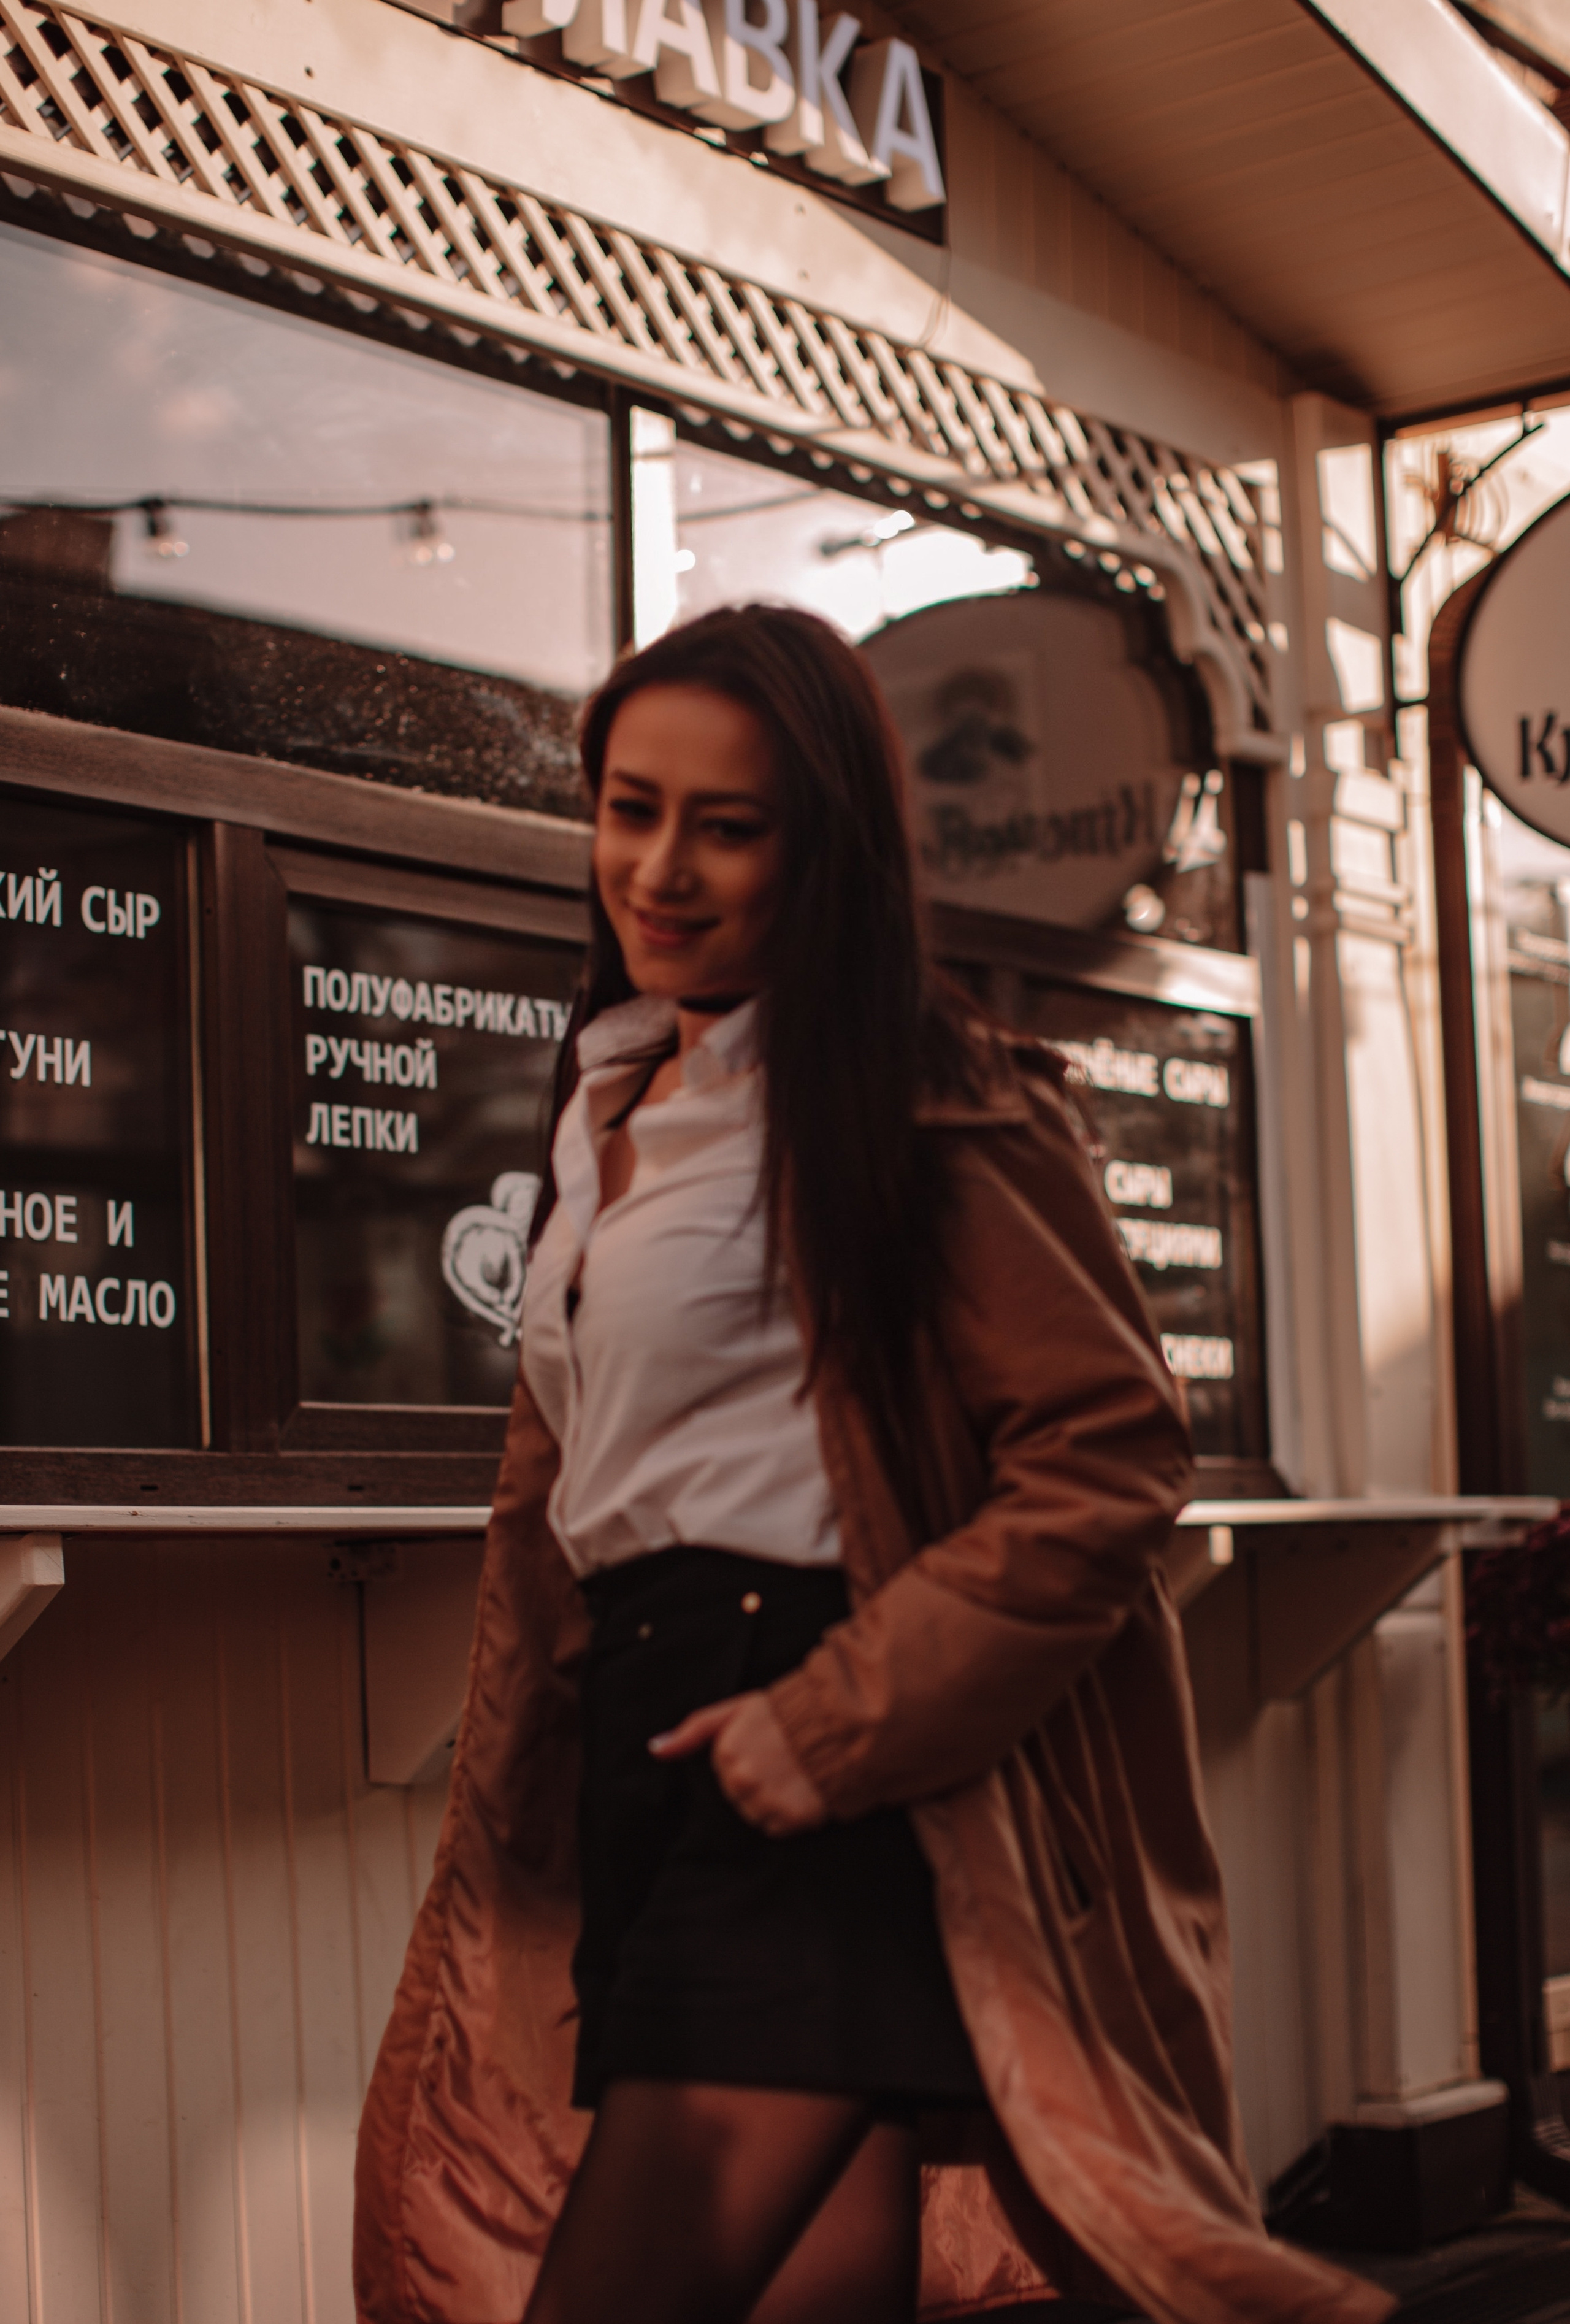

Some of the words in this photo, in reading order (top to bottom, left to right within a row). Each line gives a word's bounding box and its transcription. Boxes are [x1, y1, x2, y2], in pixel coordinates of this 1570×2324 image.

[0, 867, 62, 928] ИЙ
[80, 885, 161, 940] СЫР
[0, 1029, 91, 1087] УНИ
[305, 1033, 438, 1090] РУЧНОЙ
[306, 1102, 419, 1154] ЛЕПКИ
[0, 1189, 78, 1244] НОЕ
[107, 1199, 134, 1248] И
[39, 1273, 177, 1329] МАСЛО
